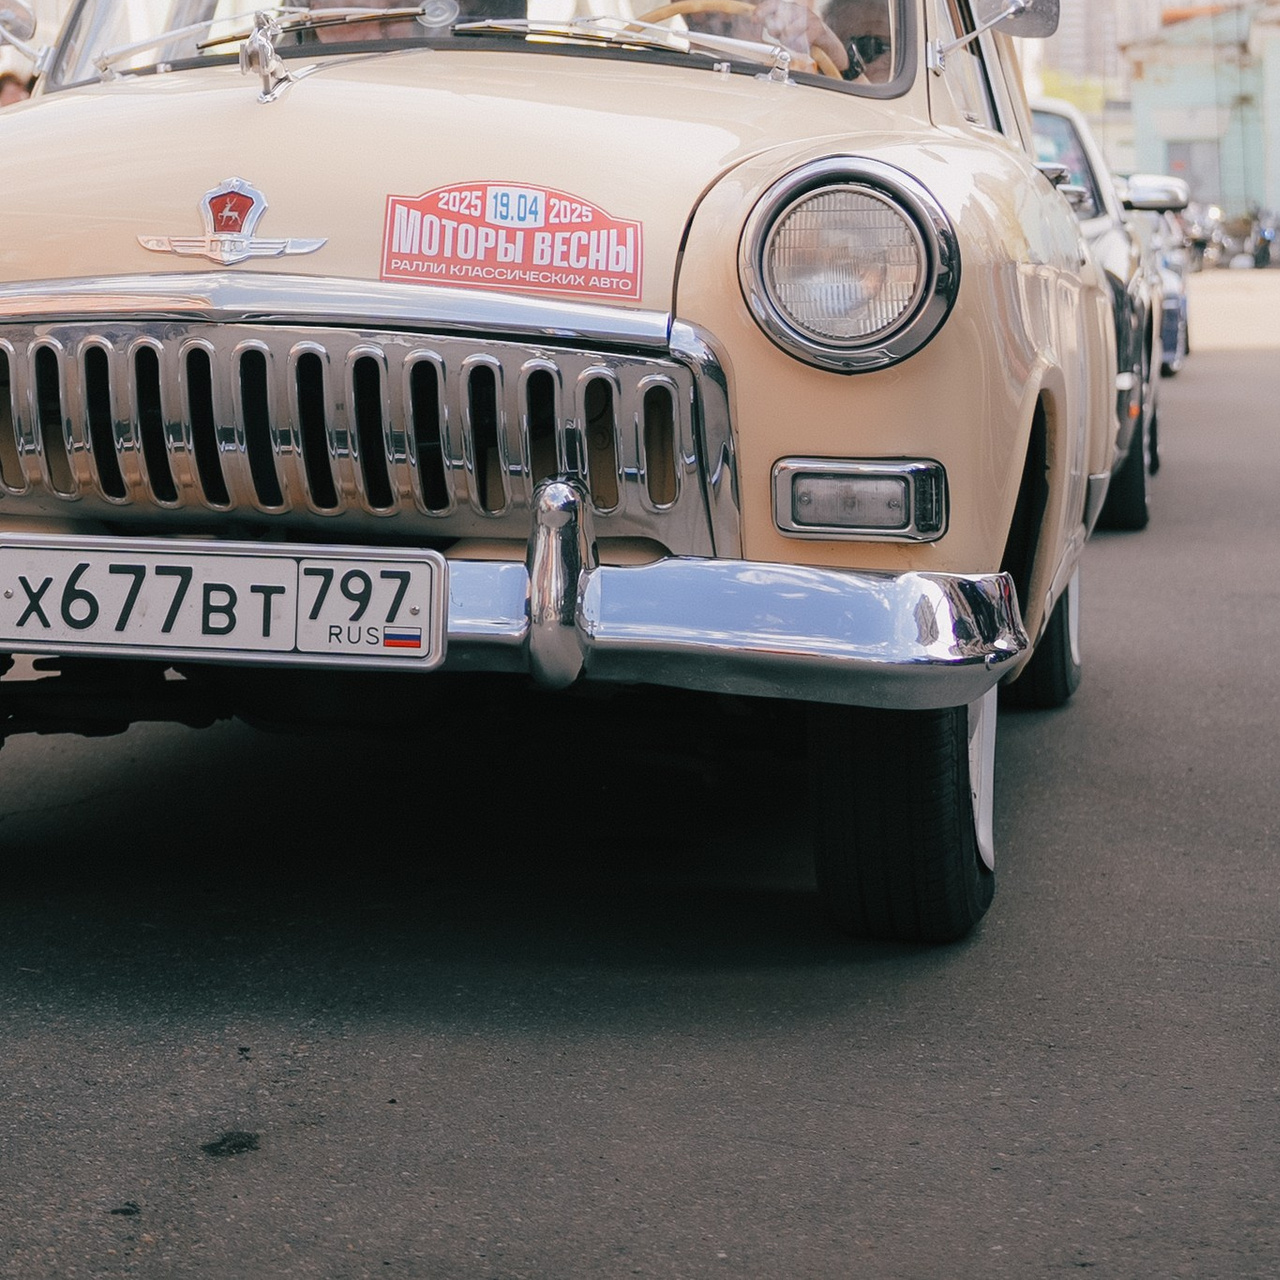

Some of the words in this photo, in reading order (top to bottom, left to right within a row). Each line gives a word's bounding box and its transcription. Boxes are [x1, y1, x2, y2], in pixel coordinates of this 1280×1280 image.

[438, 191, 482, 217] 2025
[492, 192, 539, 222] 19.04
[549, 198, 593, 223] 2025
[391, 204, 524, 263] МОТОРЫ
[533, 227, 634, 273] ВЕСНЫ
[391, 259, 446, 275] РАЛЛИ
[450, 264, 585, 286] КЛАССИЧЕСКИХ
[588, 276, 632, 290] АВТО
[303, 567, 412, 623] 797
[328, 625, 379, 645] RUS
